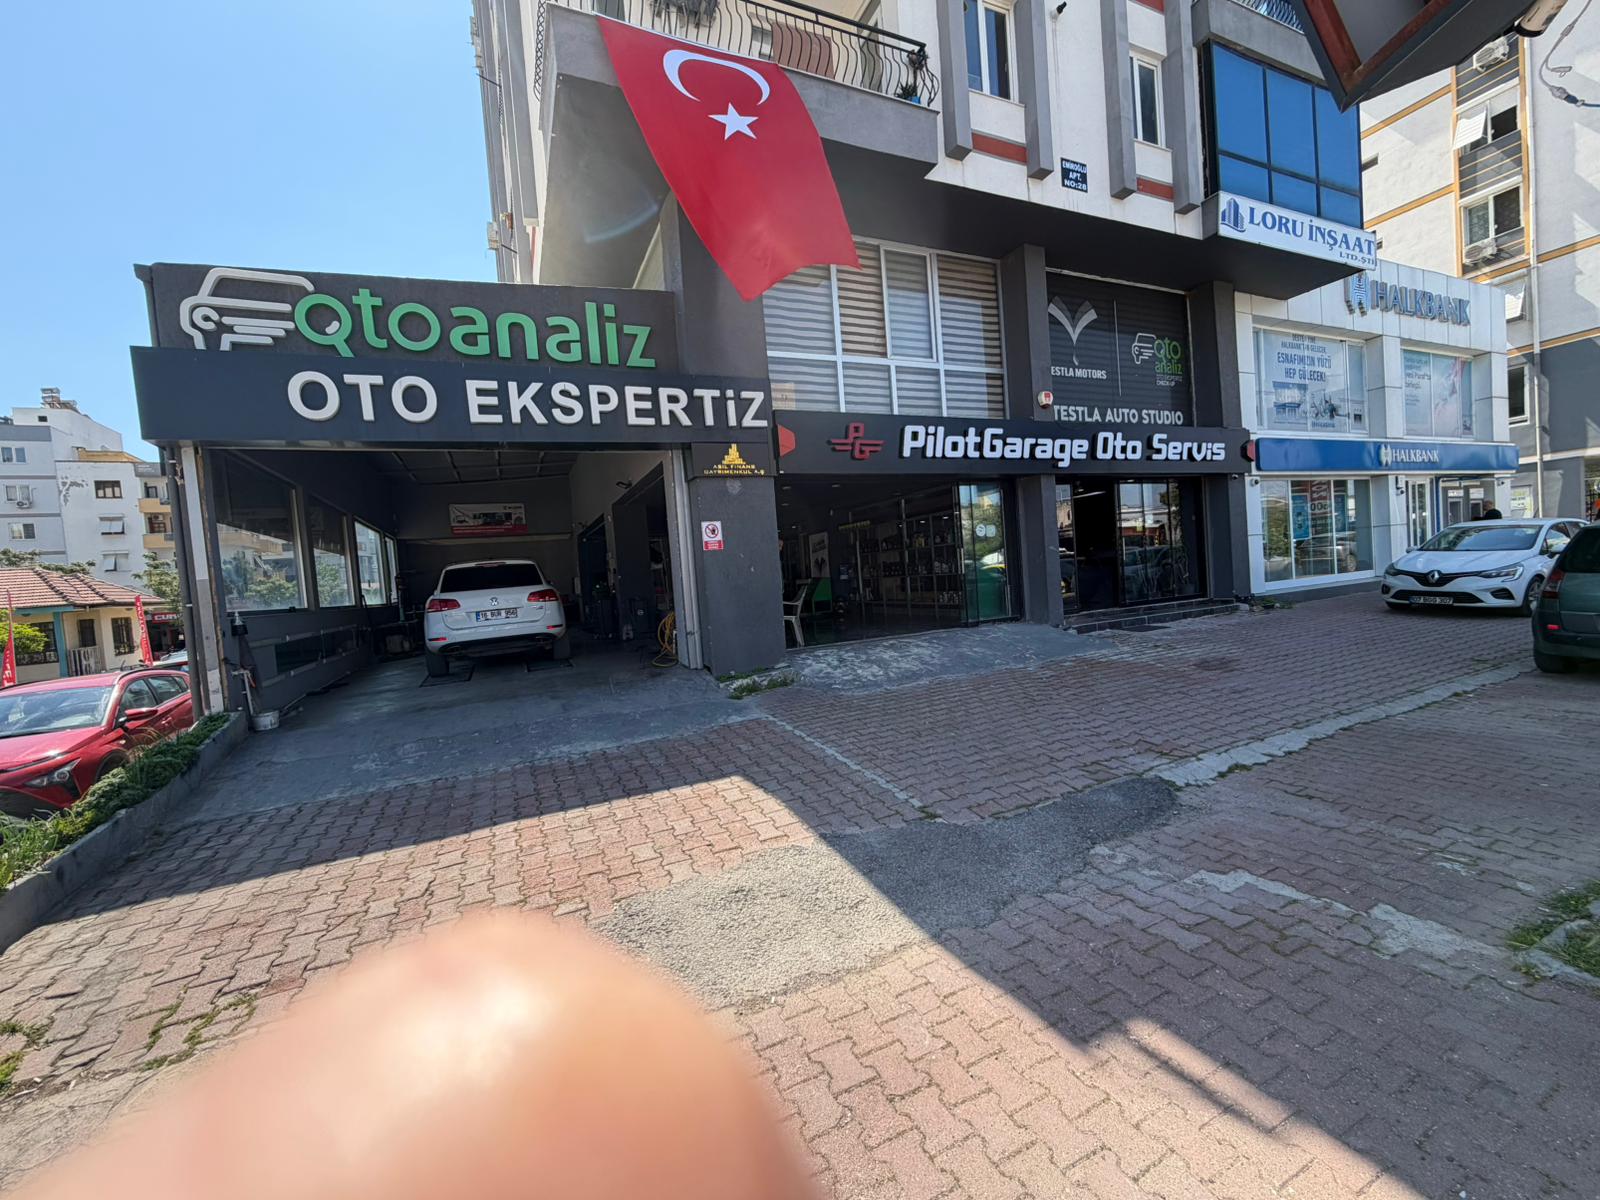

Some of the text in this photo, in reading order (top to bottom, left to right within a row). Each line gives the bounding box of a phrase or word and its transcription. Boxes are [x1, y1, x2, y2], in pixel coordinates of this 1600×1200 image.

[1248, 206, 1375, 256] LORU İNŞAAT
[1370, 279, 1471, 327] HALKBANK
[1051, 366, 1107, 379] ESTLA MOTORS
[1284, 367, 1297, 379] HEP
[287, 371, 438, 423] OTO
[1053, 405, 1184, 425] TESTLA AUTO STUDIO
[902, 425, 1226, 468] PilotGarage Oto Servis
[1392, 448, 1439, 464] HALKBANK
